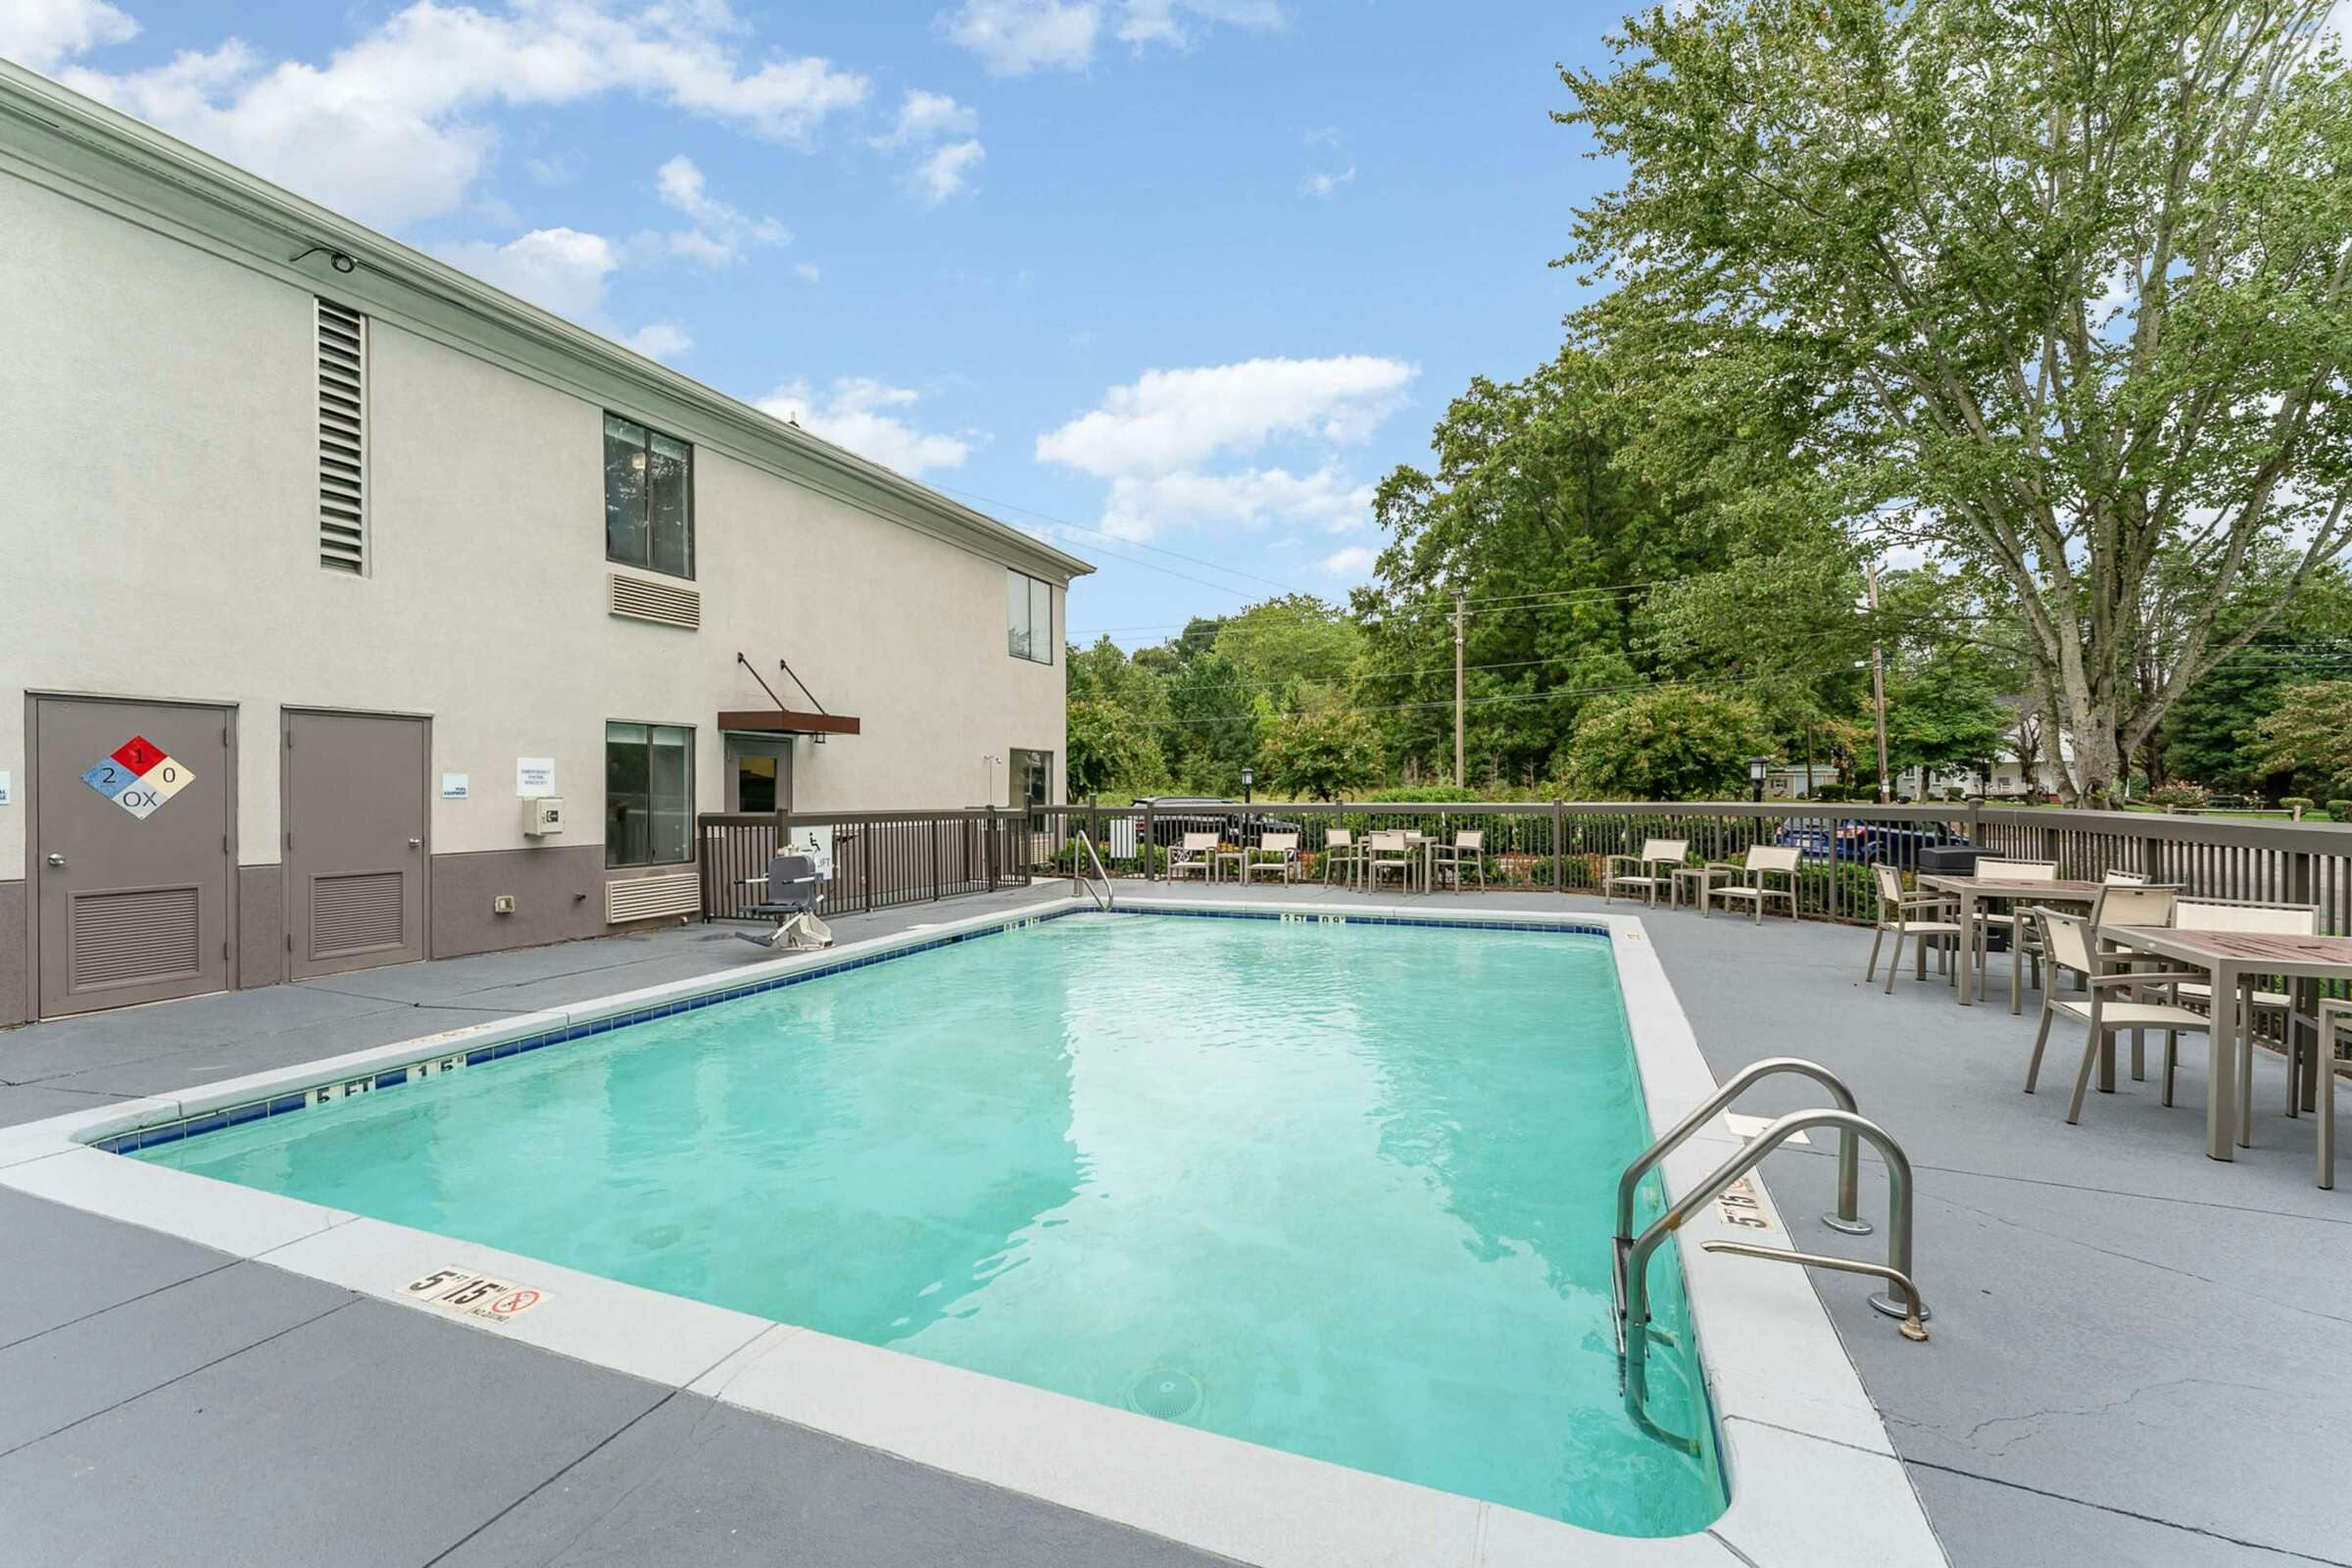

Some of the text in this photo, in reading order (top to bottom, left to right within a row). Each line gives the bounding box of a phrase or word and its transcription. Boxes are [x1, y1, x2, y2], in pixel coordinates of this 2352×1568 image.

[133, 748, 146, 763] 1
[102, 767, 117, 784] 2
[163, 767, 175, 783] 0
[122, 791, 158, 808] OX
[317, 1078, 373, 1104] 5 FT
